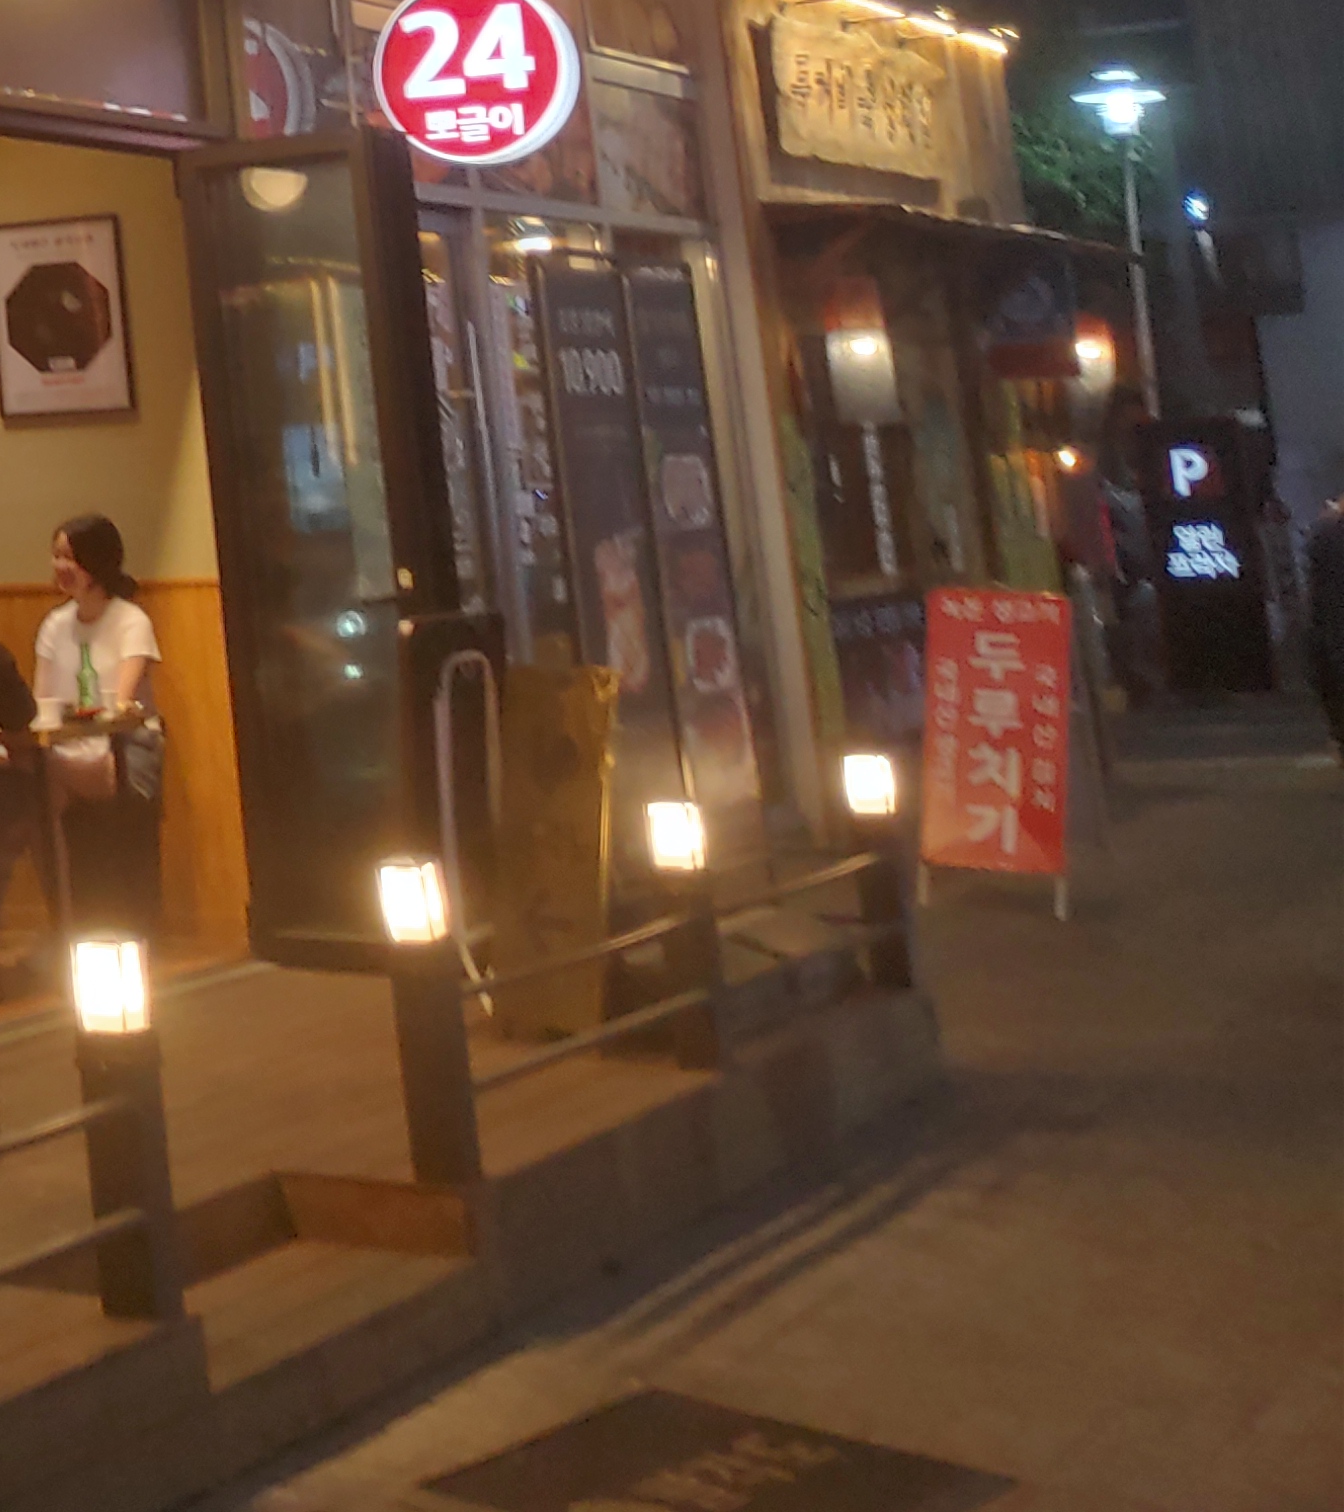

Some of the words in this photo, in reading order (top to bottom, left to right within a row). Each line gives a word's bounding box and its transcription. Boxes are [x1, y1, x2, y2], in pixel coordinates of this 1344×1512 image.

[399, 3, 536, 99] 24
[424, 104, 525, 143] 뽀글이
[1169, 449, 1208, 497] P
